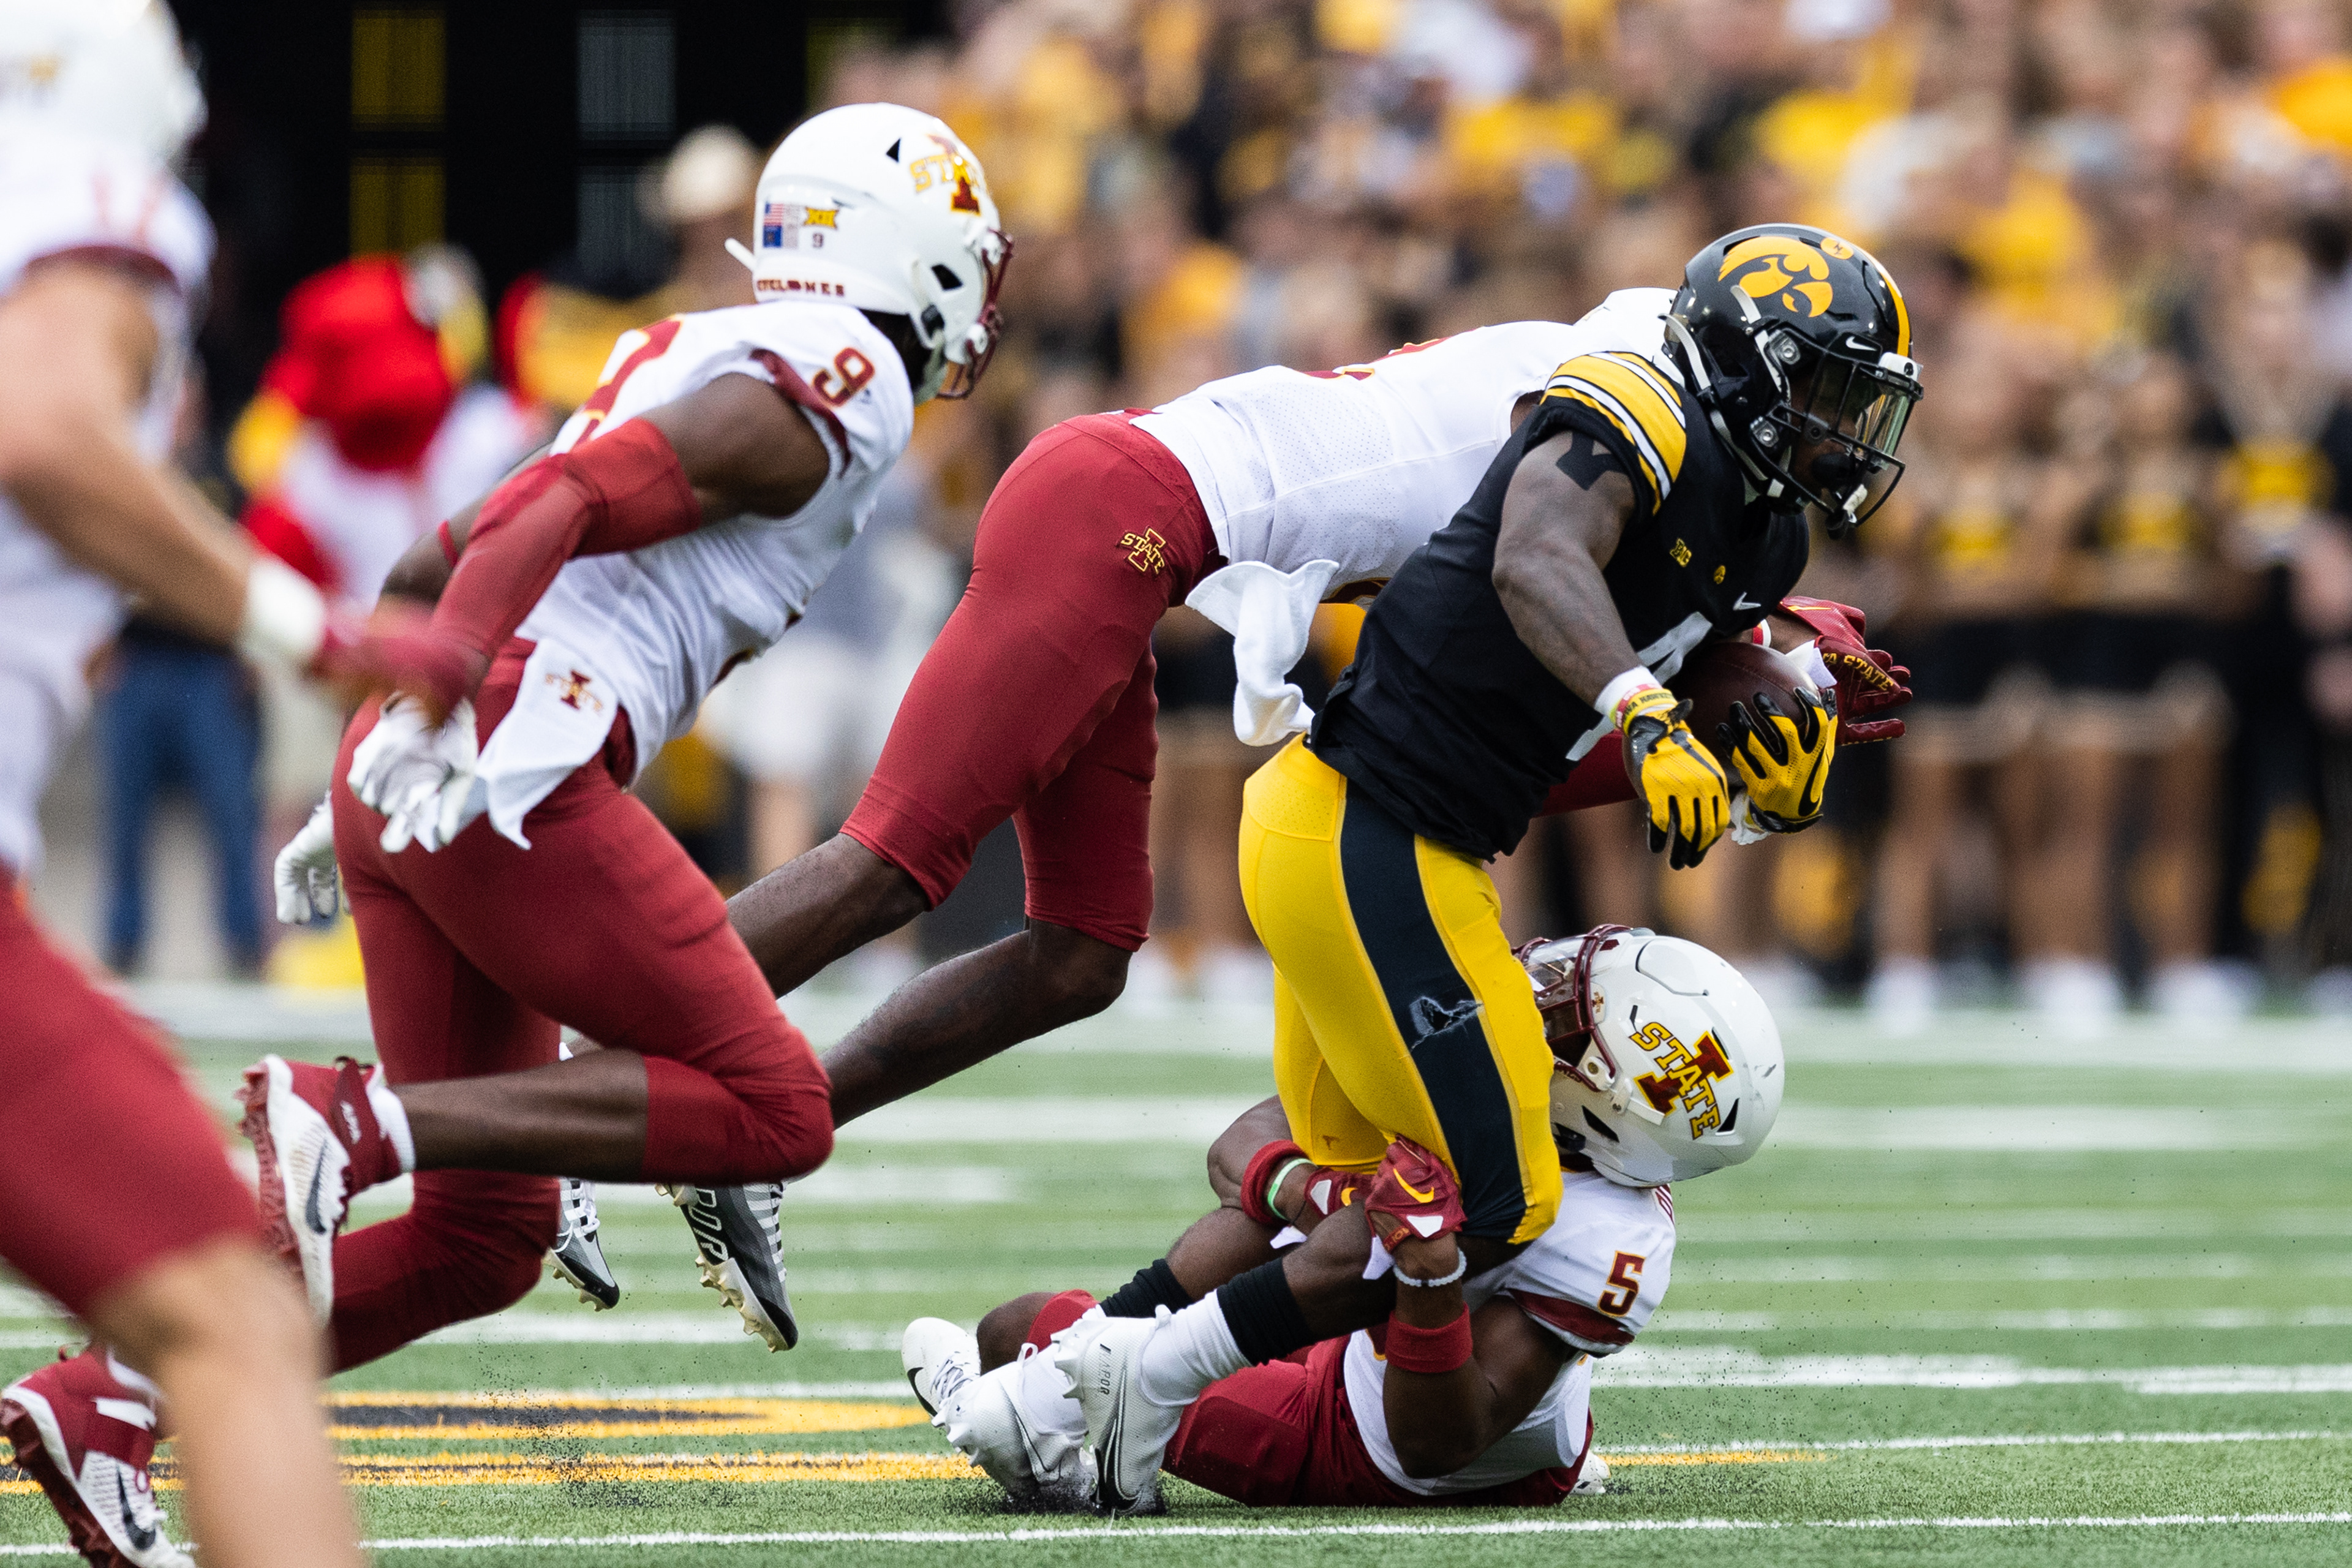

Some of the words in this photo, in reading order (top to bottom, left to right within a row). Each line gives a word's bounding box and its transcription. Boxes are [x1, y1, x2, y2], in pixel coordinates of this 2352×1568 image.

[812, 347, 876, 407] 9
[1120, 533, 1165, 575] STATE
[1844, 654, 1894, 691] STATE
[1629, 1022, 1721, 1140] STATE
[1597, 1250, 1646, 1317] 5
